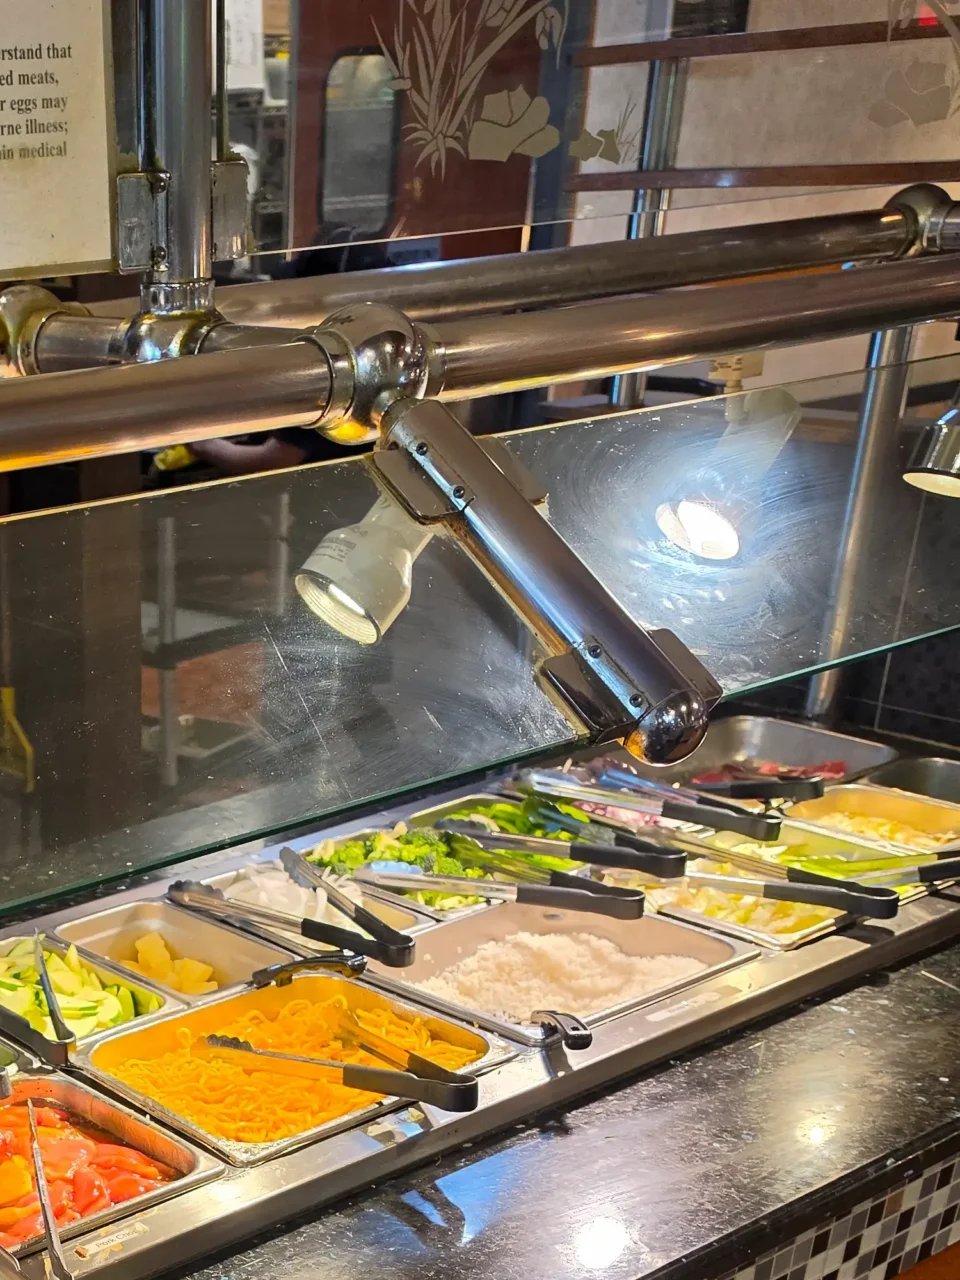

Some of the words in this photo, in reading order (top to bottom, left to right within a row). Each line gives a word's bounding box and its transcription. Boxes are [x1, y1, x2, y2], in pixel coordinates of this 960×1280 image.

[46, 43, 73, 59] that
[18, 70, 60, 86] meats,
[10, 99, 38, 115] eggs
[41, 96, 68, 113] may
[25, 118, 69, 135] illness;
[19, 140, 67, 159] medical
[95, 1238, 115, 1248] Pork
